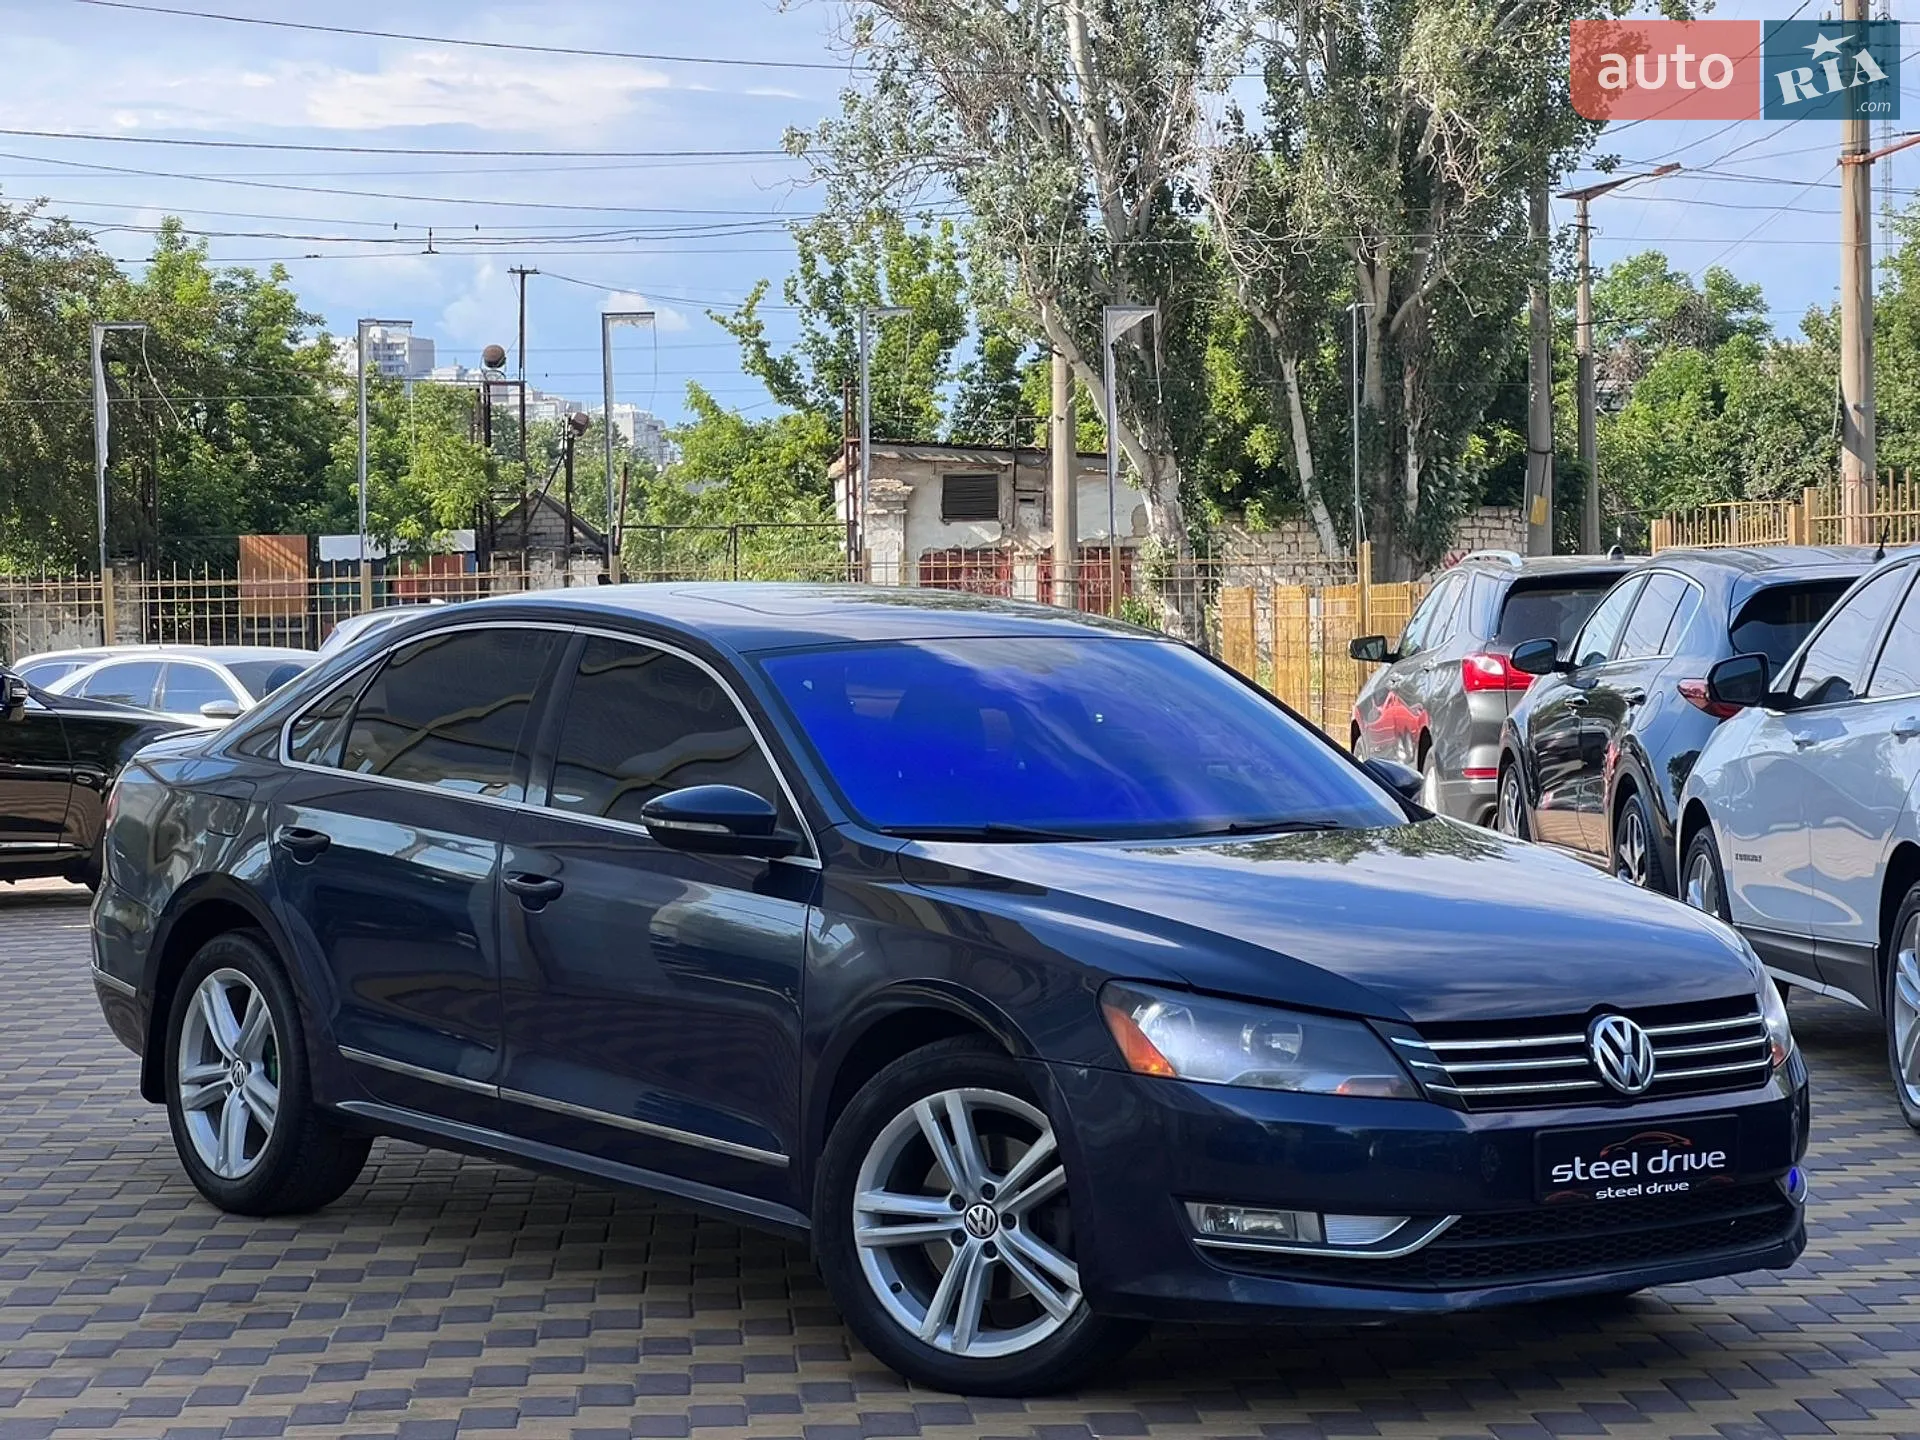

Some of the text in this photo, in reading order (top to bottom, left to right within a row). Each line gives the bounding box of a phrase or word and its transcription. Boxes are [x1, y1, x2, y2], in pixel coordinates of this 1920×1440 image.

[1552, 1149, 1726, 1183] steel drive
[1596, 1181, 1690, 1200] steel drive
